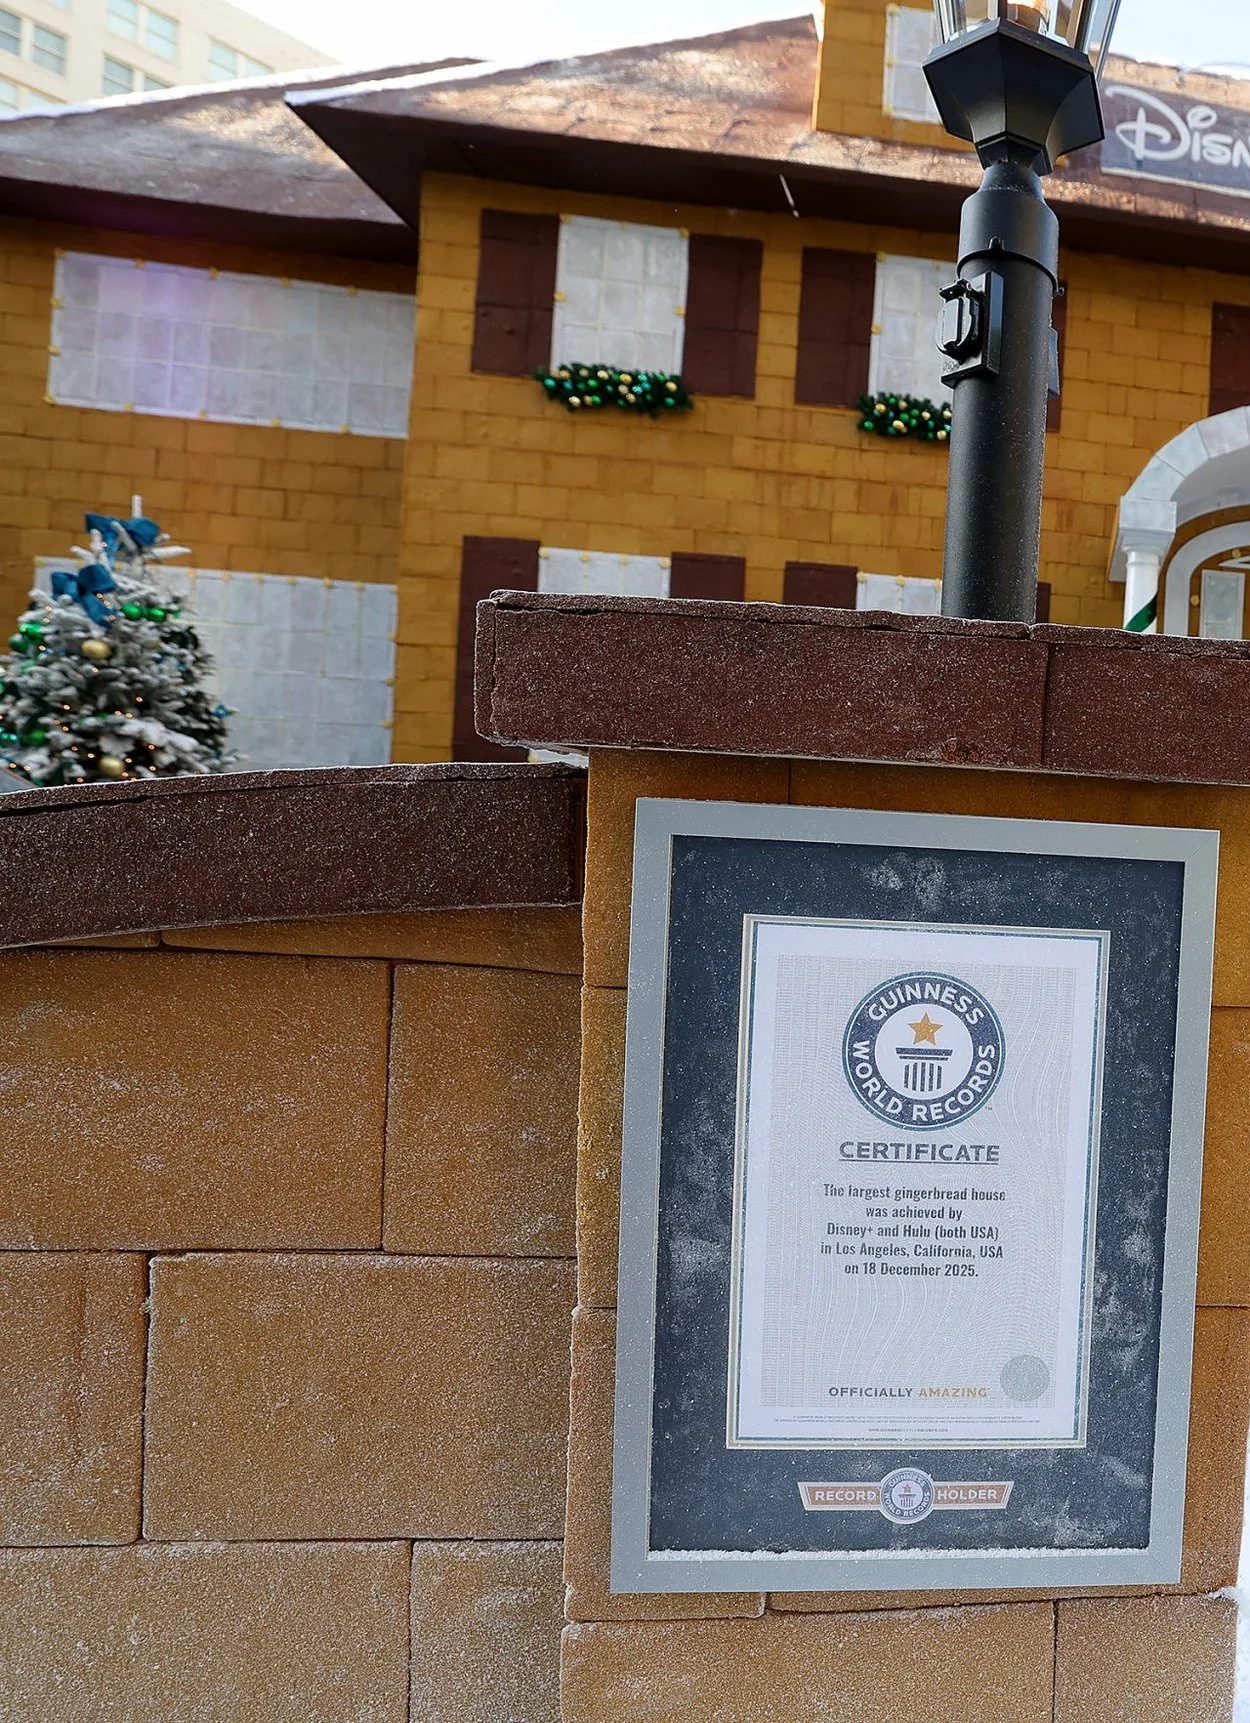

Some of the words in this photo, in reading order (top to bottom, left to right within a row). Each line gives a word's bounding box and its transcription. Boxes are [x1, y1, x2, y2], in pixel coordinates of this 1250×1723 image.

[868, 982, 985, 1025] GUINNESS
[853, 1040, 903, 1115] WORLD
[912, 1044, 995, 1121] RECORDS
[839, 1141, 1000, 1162] CERTIFICATE
[823, 1184, 845, 1197] The
[848, 1184, 890, 1201] largest
[894, 1187, 967, 1202] gingerbread
[971, 1188, 1006, 1201] house
[865, 1207, 888, 1218] was
[891, 1206, 944, 1219] achieved
[948, 1207, 963, 1221] by
[827, 1222, 873, 1238] Disney+
[877, 1224, 899, 1237] and
[903, 1225, 930, 1238] Hulu
[935, 1225, 966, 1240] (both
[970, 1226, 999, 1241] USA)
[821, 1242, 832, 1254] in
[836, 1242, 856, 1255] Los
[859, 1243, 910, 1259] Angeles,
[913, 1244, 976, 1260] California,
[980, 1246, 1004, 1259] USA
[844, 1264, 859, 1274] on
[863, 1262, 876, 1275] 18
[880, 1263, 941, 1276] December
[944, 1264, 979, 1277] 2025.
[828, 1386, 913, 1398] OFFICIALLY
[918, 1387, 988, 1398] AMAZING
[888, 1472, 926, 1487] GUINNESS
[815, 1490, 877, 1501] RECORD
[937, 1489, 998, 1500] HOLDER
[885, 1492, 902, 1515] WORLD
[903, 1491, 931, 1517] RECORDS
